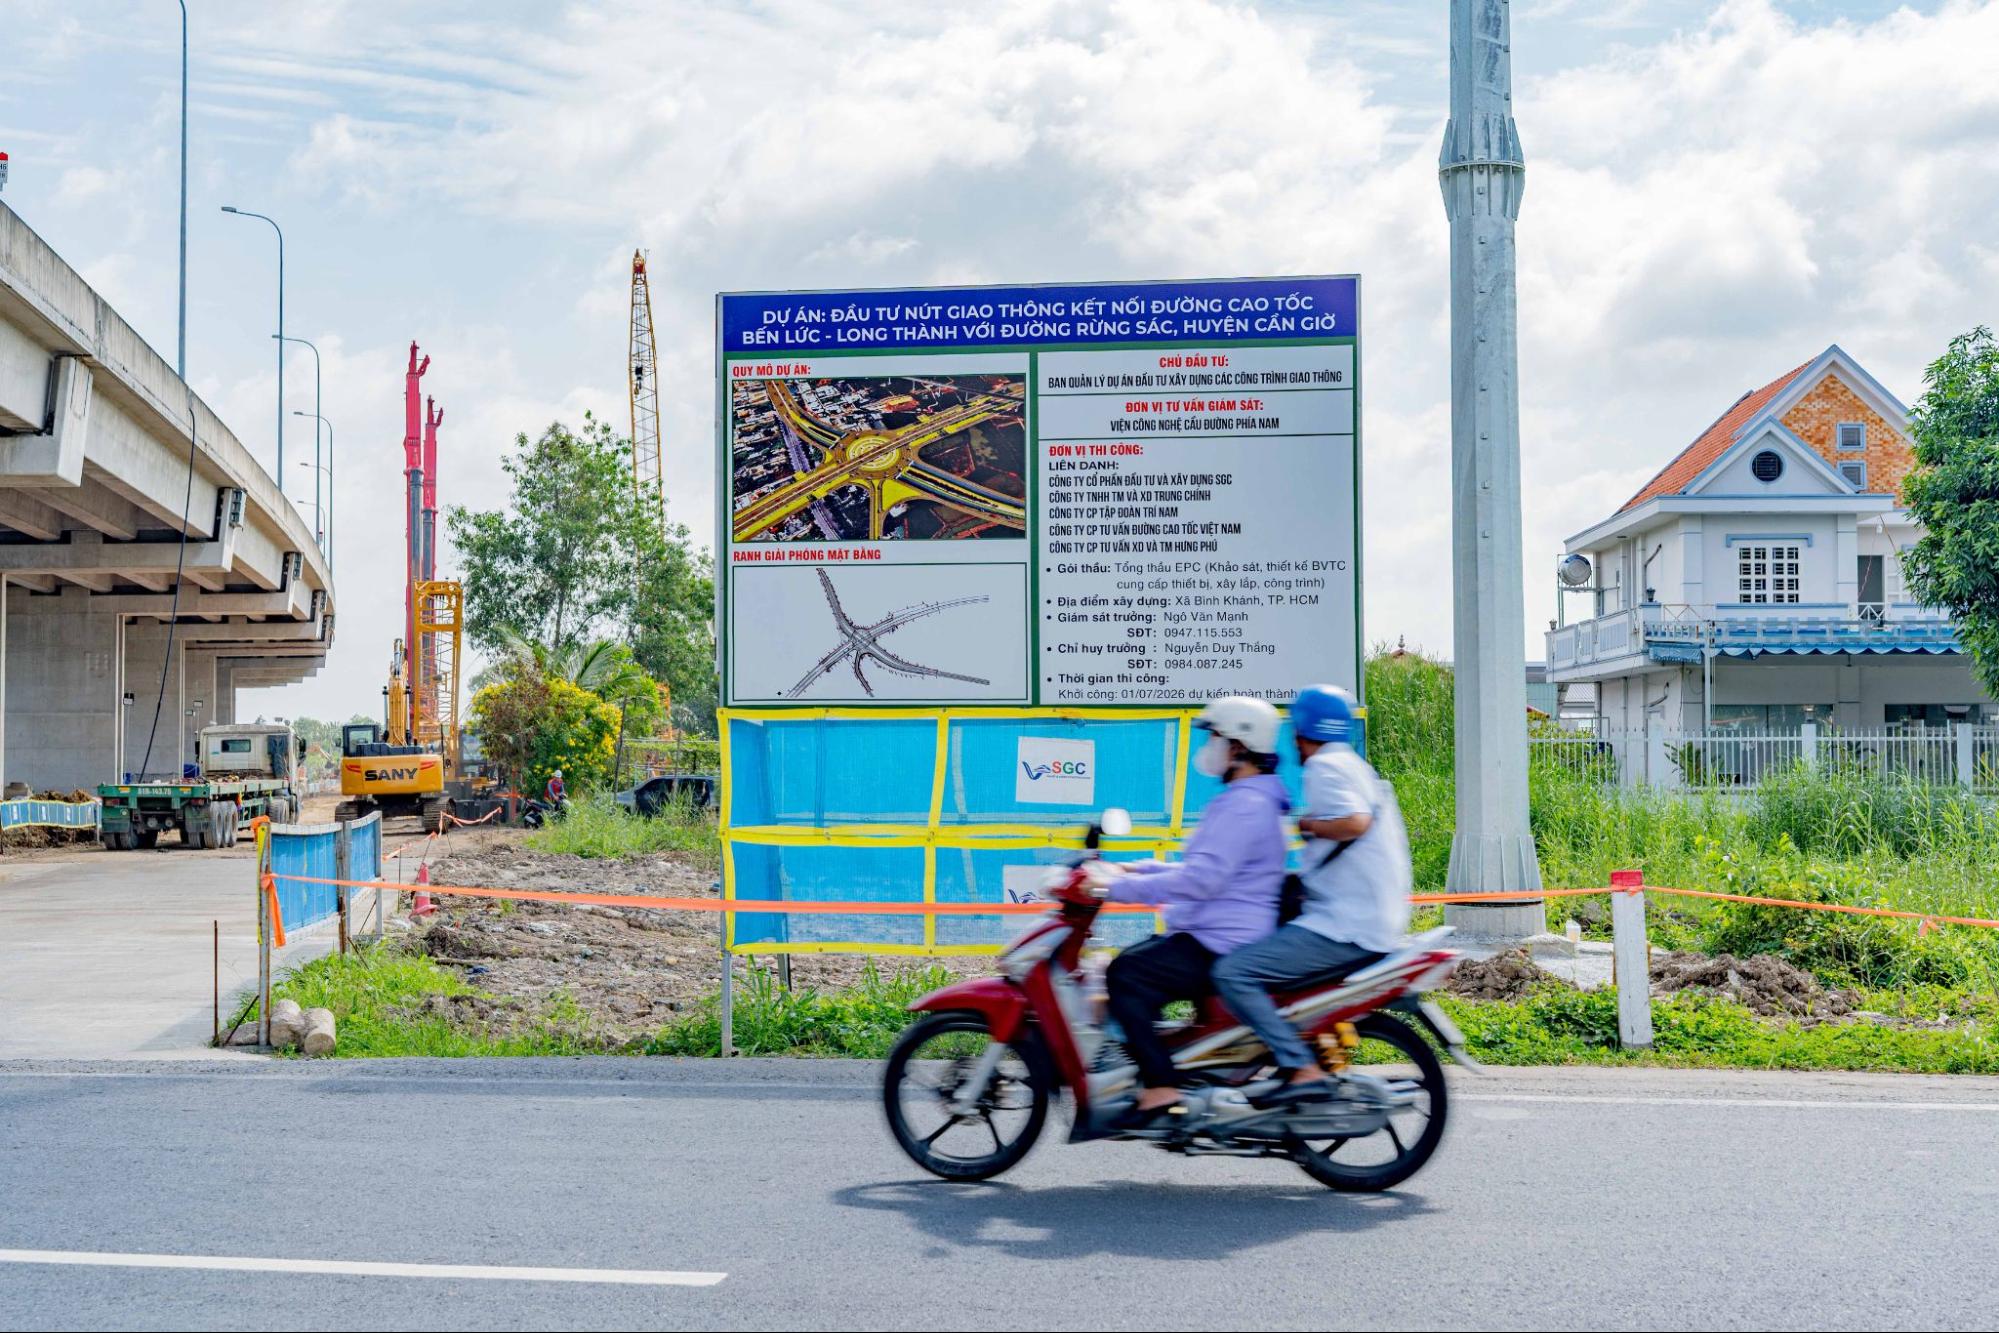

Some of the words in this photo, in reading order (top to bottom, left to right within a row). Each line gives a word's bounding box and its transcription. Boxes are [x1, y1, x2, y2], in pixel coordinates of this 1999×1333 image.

[763, 307, 790, 328] DỰ
[794, 306, 826, 323] ÁN:
[830, 304, 870, 322] ĐẦU
[875, 304, 900, 321] TƯ
[905, 302, 943, 320] NÚT
[947, 304, 994, 319] GIAO
[998, 300, 1065, 318] THÔNG
[1071, 298, 1106, 316] KẾT
[1112, 296, 1145, 315] NỐI
[1150, 296, 1222, 314] ĐƯỜNG
[1228, 297, 1269, 312] CAO
[1273, 292, 1314, 312] TỐC
[742, 326, 779, 344] BẾN
[785, 326, 820, 344] LỨC
[837, 327, 888, 342] LONG
[892, 322, 957, 341] THÀNH
[962, 321, 995, 339] VỚI
[1000, 320, 1070, 338] ĐƯỜNG
[1077, 318, 1130, 336] RỪNG
[1136, 317, 1178, 336] SÁC,
[1184, 315, 1249, 335] HUYỆN
[1254, 313, 1295, 332] CẦN
[1300, 312, 1336, 330] GIỜ
[1159, 354, 1182, 368] CHỦ
[1185, 353, 1208, 368] ĐẦU
[1211, 354, 1229, 367] TƯ:
[732, 366, 753, 378] QUY
[756, 363, 773, 376] MÔ
[776, 364, 791, 377] DỰ
[794, 362, 811, 375] ÁN:
[1048, 377, 1066, 388] BAN
[1068, 374, 1092, 388] QUẢN
[1094, 374, 1106, 388] LÝ
[1107, 375, 1120, 388] DỰ
[1121, 374, 1133, 387] ÁN
[1135, 372, 1154, 387] ĐẦU
[1155, 374, 1167, 386] TƯ
[1169, 372, 1187, 386] XÂY
[1189, 374, 1213, 387] DỰNG
[1215, 372, 1233, 385] CÁC
[1234, 371, 1258, 385] CÔNG
[1260, 370, 1288, 384] TRÌNH
[1289, 371, 1310, 384] GIAO
[1312, 369, 1342, 383] THÔNG
[1125, 401, 1148, 412] ĐƠN
[1152, 402, 1162, 414] VỊ
[1166, 400, 1180, 412] TƯ
[1183, 398, 1204, 412] VẤN
[1208, 398, 1236, 412] GIÁM
[1240, 398, 1264, 411] SÁT:
[1110, 418, 1131, 433] VIỆN
[1132, 418, 1156, 431] CÔNG
[1158, 417, 1182, 432] NGHỆ
[1184, 416, 1202, 430] CẦU
[1204, 416, 1234, 430] ĐƯỜNG
[1236, 416, 1257, 429] PHÍA
[1258, 417, 1280, 429] NAM
[1049, 444, 1072, 456] ĐƠN
[1075, 446, 1086, 458] VỊ
[1089, 445, 1107, 456] THI
[1110, 442, 1144, 456] CÔNG:
[1049, 459, 1076, 471] LIÊN
[1079, 461, 1119, 470] DANH:
[1049, 474, 1072, 488] CÔNG
[1074, 476, 1084, 487] TY
[1086, 472, 1098, 487] CỔ
[1100, 473, 1123, 486] PHẦN
[1124, 472, 1142, 486] ĐẦU
[1144, 474, 1156, 486] TƯ
[1156, 473, 1169, 486] VÀ
[1170, 472, 1188, 486] XÂY
[1190, 474, 1214, 487] DỰNG
[1215, 474, 1232, 485] SGC
[1049, 506, 1072, 519] CÔNG
[1074, 508, 1084, 518] TY
[1086, 508, 1098, 519] CP
[1099, 506, 1116, 519] TẬP
[1117, 505, 1141, 518] ĐOÀN
[1143, 506, 1156, 518] TRÍ
[1158, 506, 1178, 518] NAM
[1049, 523, 1072, 536] CÔNG
[1073, 524, 1085, 536] TY
[1086, 524, 1098, 536] CP
[1099, 524, 1111, 536] TƯ
[1112, 522, 1130, 536] VẤN
[1132, 522, 1161, 535] ĐƯỜNG
[1162, 524, 1180, 535] CAO
[1182, 521, 1198, 534] TỐC
[1200, 521, 1219, 536] VIỆT
[1221, 523, 1241, 534] NAM
[734, 551, 761, 562] RANH
[764, 548, 785, 561] GIẢI
[788, 550, 824, 561] PHÓNG
[828, 548, 850, 562] MẶT
[853, 547, 881, 560] BẰNG
[1057, 563, 1078, 574] Gói
[1081, 562, 1111, 573] thầu:
[1114, 561, 1143, 576] Tổng
[1147, 561, 1171, 572] thầu
[1175, 562, 1201, 572] EPC
[1205, 560, 1239, 574] (Khảo
[1242, 562, 1263, 573] sát,
[1266, 560, 1291, 572] thiết
[1294, 560, 1308, 571] kế
[1312, 560, 1346, 571] BVTC
[1116, 581, 1144, 592] cung
[1148, 578, 1168, 591] cấp
[1172, 577, 1196, 589] thiết
[1199, 579, 1212, 590] bị,
[1216, 578, 1236, 591] xây
[1240, 576, 1260, 590] lắp,
[1264, 578, 1292, 590] công
[1295, 577, 1325, 590] trình)
[1058, 597, 1077, 608] Địa
[1080, 594, 1109, 606] điểm
[1113, 596, 1134, 608] xây
[1136, 596, 1171, 608] dựng:
[1175, 595, 1191, 606] Xã
[1194, 596, 1220, 606] Bình
[1223, 595, 1264, 606] Khánh,
[1268, 594, 1285, 605] TP.
[1289, 594, 1319, 605] HCM
[1058, 612, 1088, 622] Giám
[1092, 612, 1110, 622] sát
[1113, 610, 1156, 624] trưởng:
[1164, 611, 1187, 624] Ngô
[1190, 612, 1213, 622] Văn
[1216, 611, 1248, 623] Mạnh
[1127, 628, 1156, 638] SĐT:
[1164, 627, 1243, 638] 0947.115.553
[1058, 642, 1078, 654] Chỉ
[1082, 644, 1103, 656] huy
[1106, 642, 1146, 656] trưởng
[1165, 642, 1208, 656] Nguyễn
[1212, 642, 1236, 655] Duy
[1238, 641, 1275, 655] Thắng
[1128, 659, 1157, 669] SĐT:
[1164, 659, 1243, 669] 0984.087.245
[1058, 673, 1084, 683] Thời
[1088, 673, 1113, 686] gian
[1117, 673, 1132, 683] thi
[1136, 673, 1169, 686] công:
[1058, 689, 1084, 699] Khởi
[1086, 689, 1118, 702] công:
[1121, 688, 1185, 699] 01/07/2026
[1188, 688, 1203, 701] dự
[1206, 687, 1230, 700] kiến
[1265, 688, 1298, 700] thành
[364, 768, 418, 781] SANY
[1052, 761, 1086, 775] SGC
